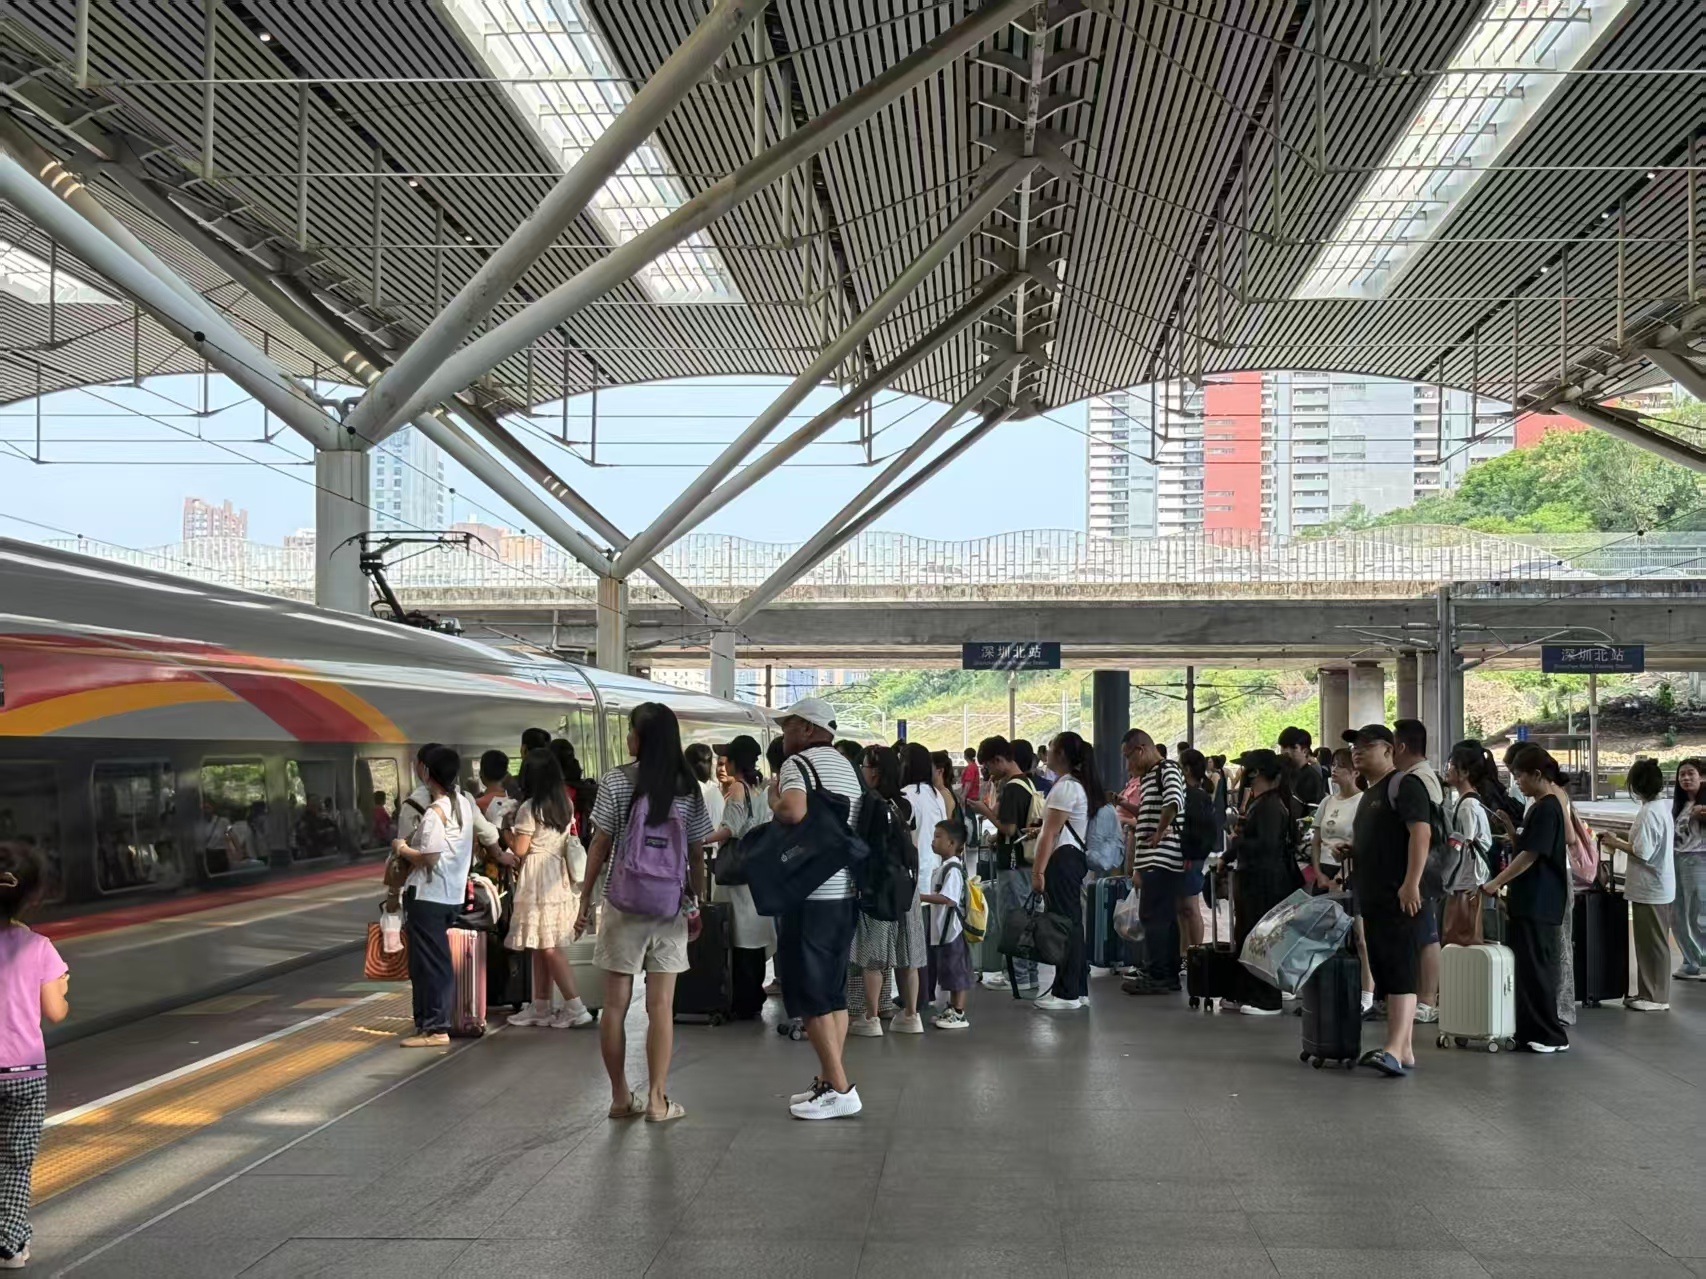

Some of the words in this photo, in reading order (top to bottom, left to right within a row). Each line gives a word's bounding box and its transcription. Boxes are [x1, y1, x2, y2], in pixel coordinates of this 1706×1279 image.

[981, 645, 1041, 659] 深圳北站
[1561, 648, 1624, 662] 深圳北站
